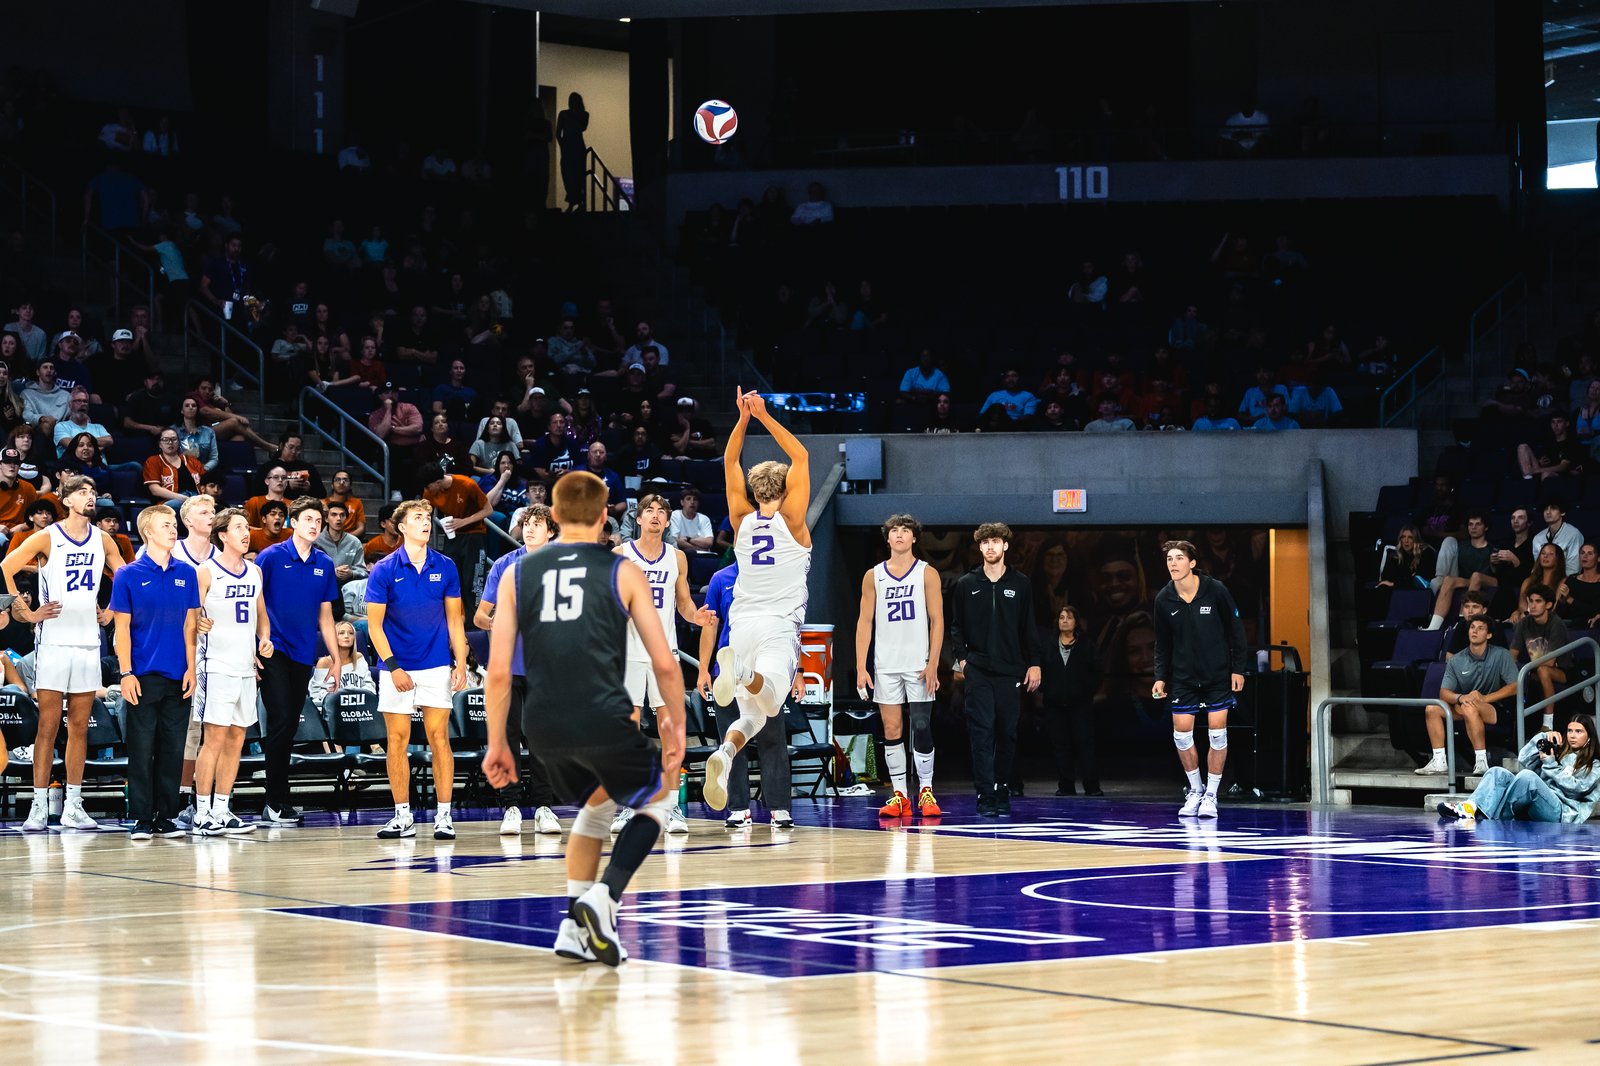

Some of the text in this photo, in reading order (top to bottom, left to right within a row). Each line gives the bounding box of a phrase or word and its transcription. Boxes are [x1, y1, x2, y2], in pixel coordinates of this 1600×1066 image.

[1055, 166, 1108, 199] 110
[1059, 491, 1081, 508] EXIT
[751, 535, 775, 565] 2
[65, 553, 95, 567] GCU
[66, 569, 95, 592] 24
[225, 585, 256, 599] GCU
[540, 566, 588, 622] 15
[885, 585, 914, 599] GCU
[235, 601, 249, 623] 6
[887, 600, 916, 622] 20
[340, 694, 366, 706] GCU
[340, 710, 373, 718] GLOBAL
